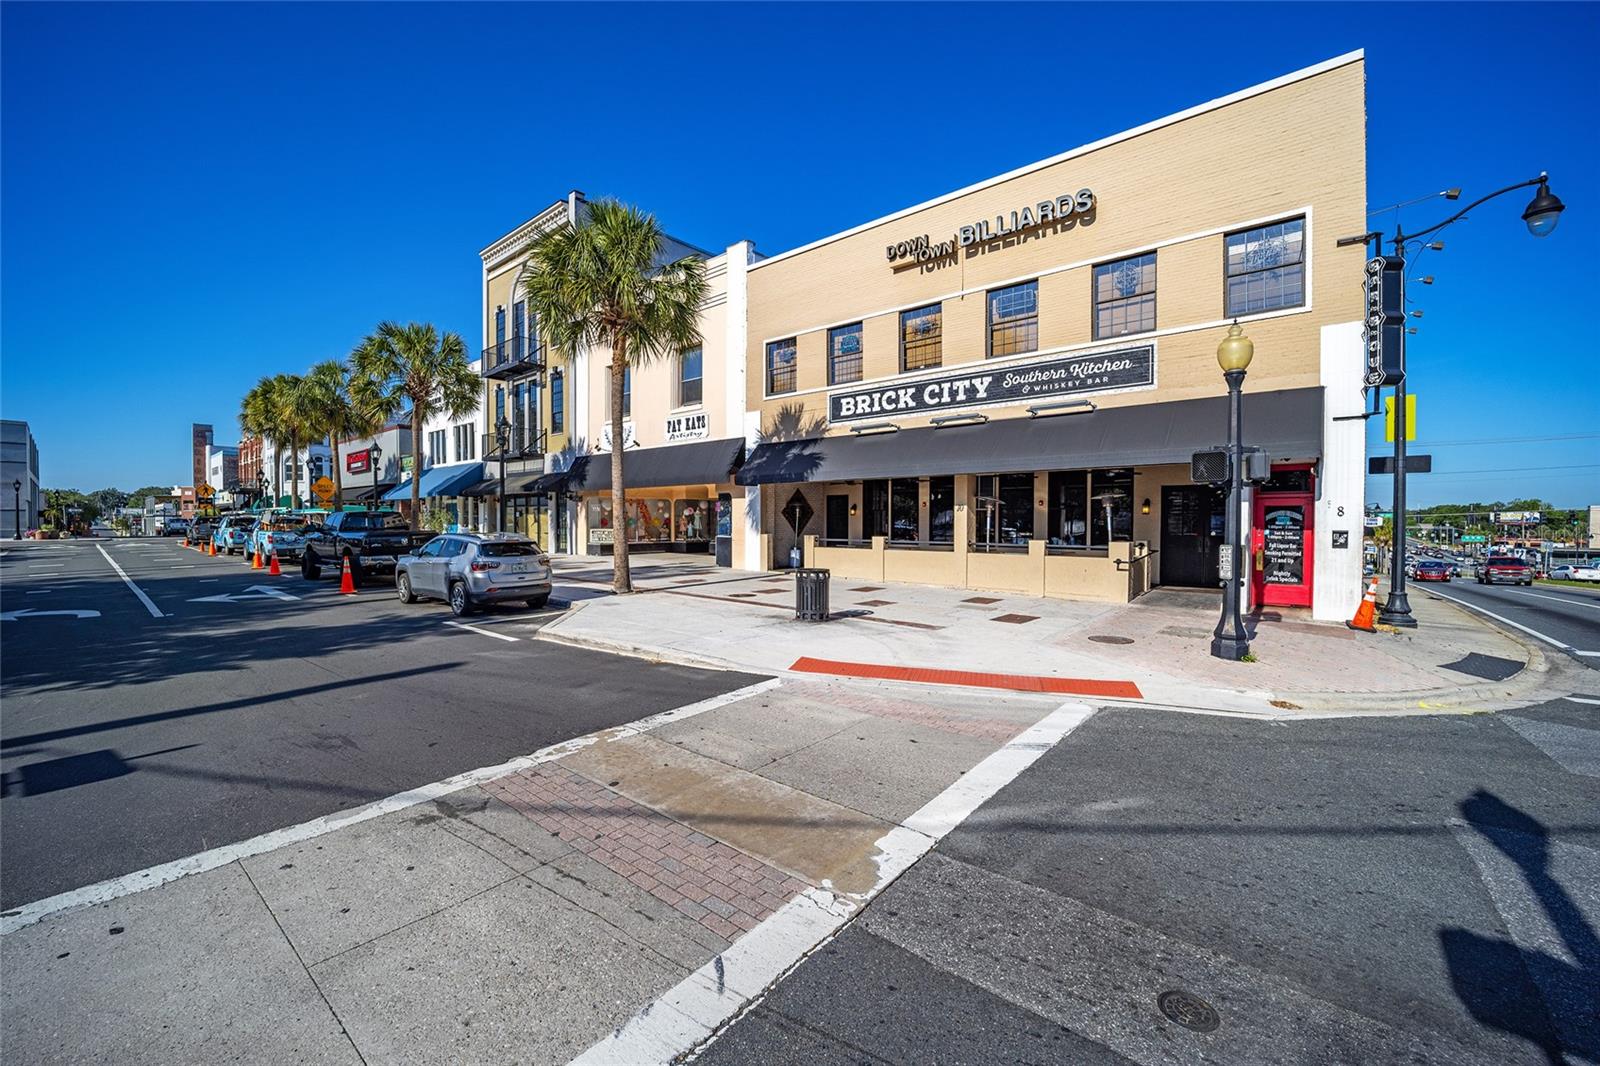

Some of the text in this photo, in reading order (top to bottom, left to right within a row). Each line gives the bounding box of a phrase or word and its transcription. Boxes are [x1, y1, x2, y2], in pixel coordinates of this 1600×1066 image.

[959, 187, 1095, 247] BILLIARDS
[886, 234, 929, 262] DOWN
[913, 240, 955, 265] TOWN
[1002, 359, 1134, 388] Southern Kitchen
[1022, 376, 1109, 394] & WHISKEY BAR
[839, 376, 993, 417] BRICK CITY
[667, 415, 706, 433] FAT KATS
[1337, 505, 1345, 517] 8
